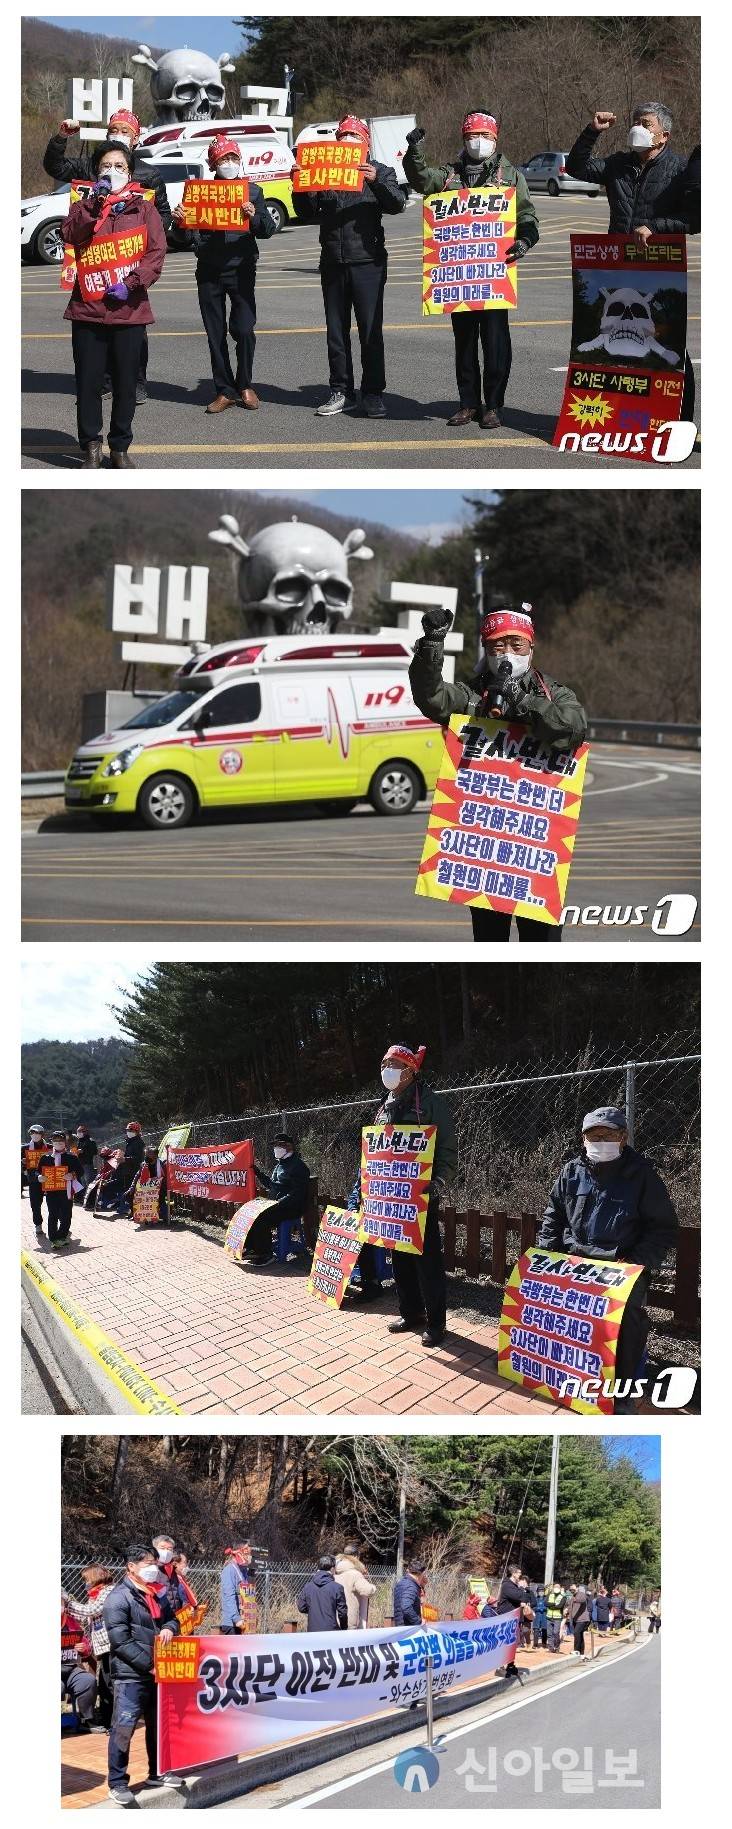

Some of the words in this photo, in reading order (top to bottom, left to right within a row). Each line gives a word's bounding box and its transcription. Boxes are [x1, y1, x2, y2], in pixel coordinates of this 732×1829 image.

[248, 151, 273, 165] 119
[302, 147, 361, 165] 일방적국방개혁
[299, 168, 358, 187] 결사반대
[185, 184, 244, 203] 일방적국방개혁
[184, 207, 244, 226] 결사반대
[430, 194, 509, 220] 결사반대
[433, 225, 470, 242] 국방부는
[471, 223, 491, 239] 한번
[494, 222, 504, 237] 더
[439, 243, 496, 262] 생각해주세요
[574, 244, 619, 261] 민군상생
[431, 266, 464, 283] 3사단이
[466, 263, 505, 280] 빠져나간
[433, 286, 460, 304] 철원의
[573, 371, 606, 389] 3사단
[654, 379, 681, 397] 이전
[578, 404, 604, 418] 강력히
[365, 686, 405, 706] 119
[460, 725, 577, 776] 결사반대
[457, 770, 514, 800] 국방부는
[516, 780, 547, 808] 한번
[549, 788, 564, 812] 더
[461, 801, 548, 841] 생각해주세요
[440, 830, 495, 862] 3사단이
[496, 839, 556, 875] 빠져나간
[438, 859, 482, 890] 철원의
[366, 1131, 428, 1152] 결사반대
[366, 1160, 391, 1176] 국방부는
[392, 1161, 409, 1178] 한번
[410, 1162, 419, 1178] 더
[369, 1180, 411, 1199] 생각해주세요
[326, 1211, 359, 1232] 결사반
[384, 1202, 417, 1221] 빠져나간
[529, 1252, 626, 1287] 결사반대
[520, 1279, 564, 1307] 국방부는
[565, 1288, 591, 1314] 한번
[592, 1295, 609, 1318] 더
[521, 1305, 593, 1345] 생각해주세요
[510, 1328, 549, 1356] 3사단이
[550, 1336, 603, 1377] 빠져나간
[510, 1352, 541, 1382] 철원의
[157, 1661, 195, 1679] 결사반대
[199, 1653, 285, 1711] 3사단
[285, 1649, 337, 1697] 이전
[338, 1644, 381, 1688] 반대
[379, 1642, 400, 1681] 및
[399, 1633, 443, 1676] 군장병
